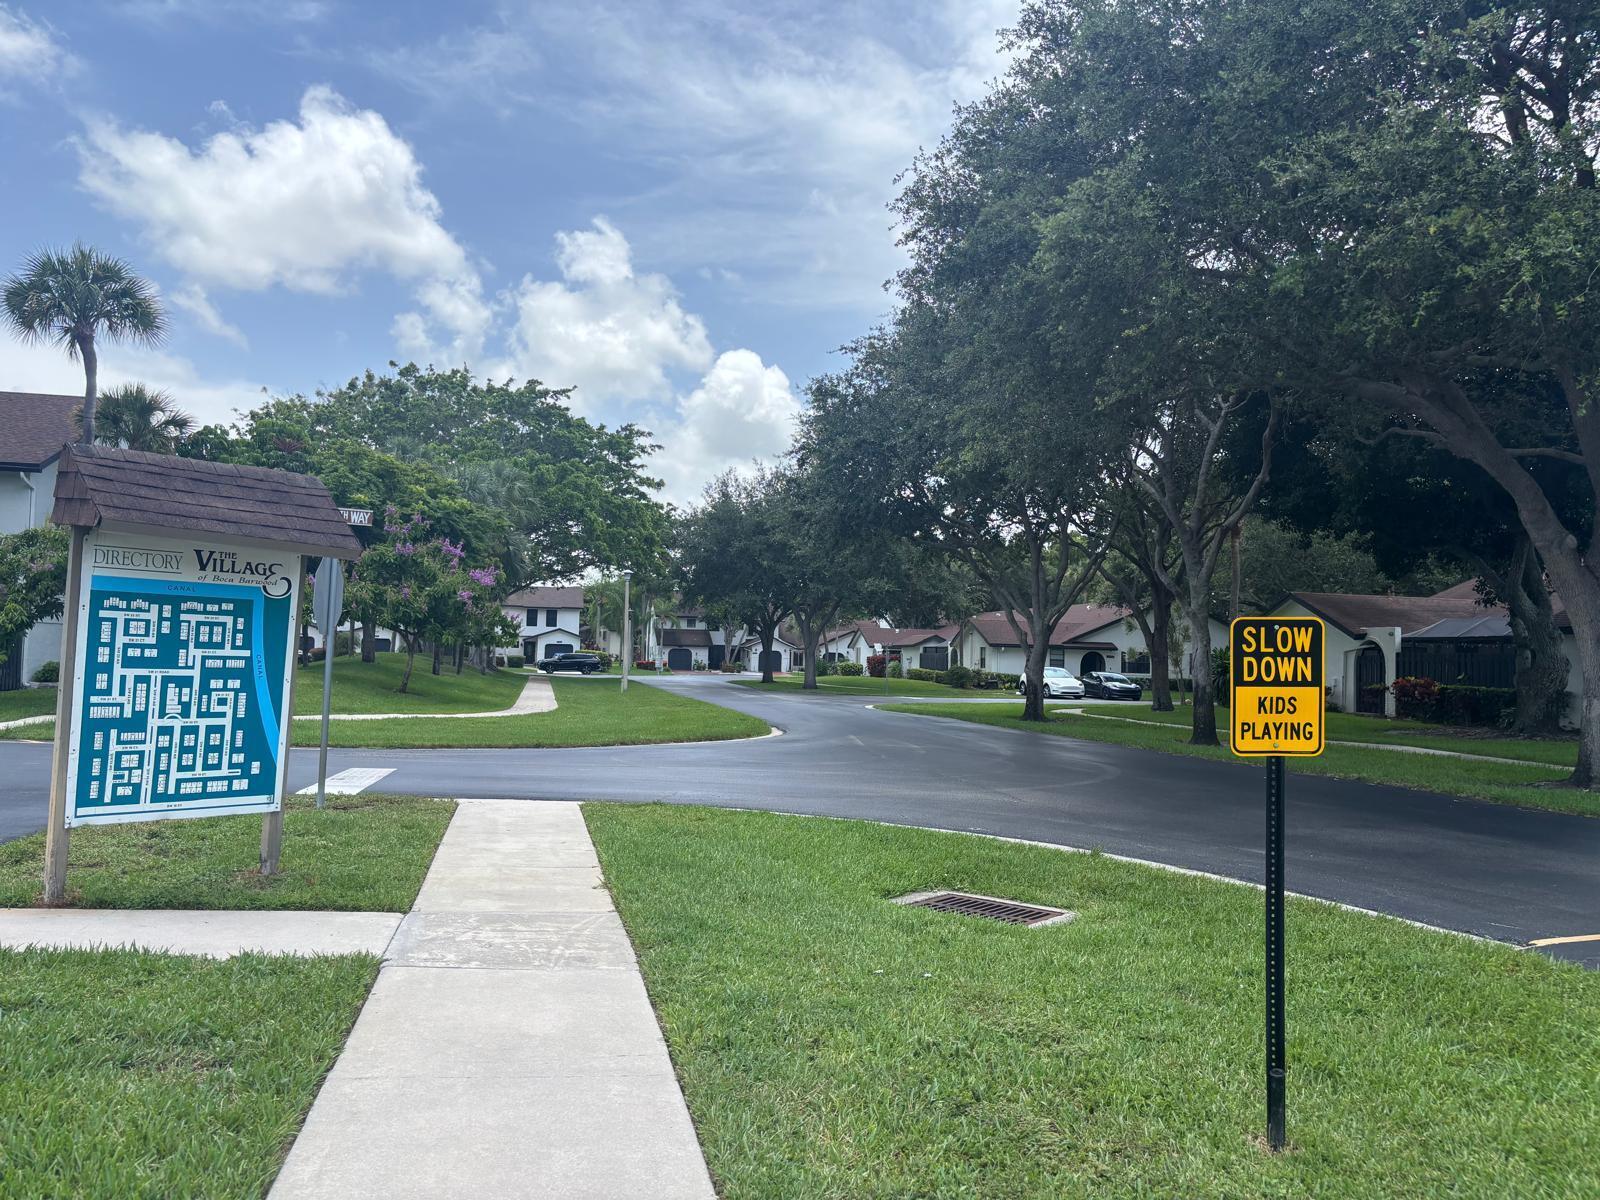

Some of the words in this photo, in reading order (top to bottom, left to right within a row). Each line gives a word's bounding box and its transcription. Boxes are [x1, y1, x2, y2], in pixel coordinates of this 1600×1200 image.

[350, 511, 370, 524] WAY
[93, 548, 183, 570] DIRECTORY
[218, 551, 238, 560] THE
[193, 549, 292, 598] VILLAGE
[197, 574, 209, 583] of
[212, 574, 234, 583] Boca
[239, 576, 278, 586] Barwood
[167, 584, 197, 593] CANAL
[1241, 626, 1313, 653] SLOW
[256, 653, 264, 680] CANAL
[1243, 656, 1312, 682] DOWN
[1257, 696, 1297, 715] KIDS
[1240, 722, 1313, 741] PLAYING
